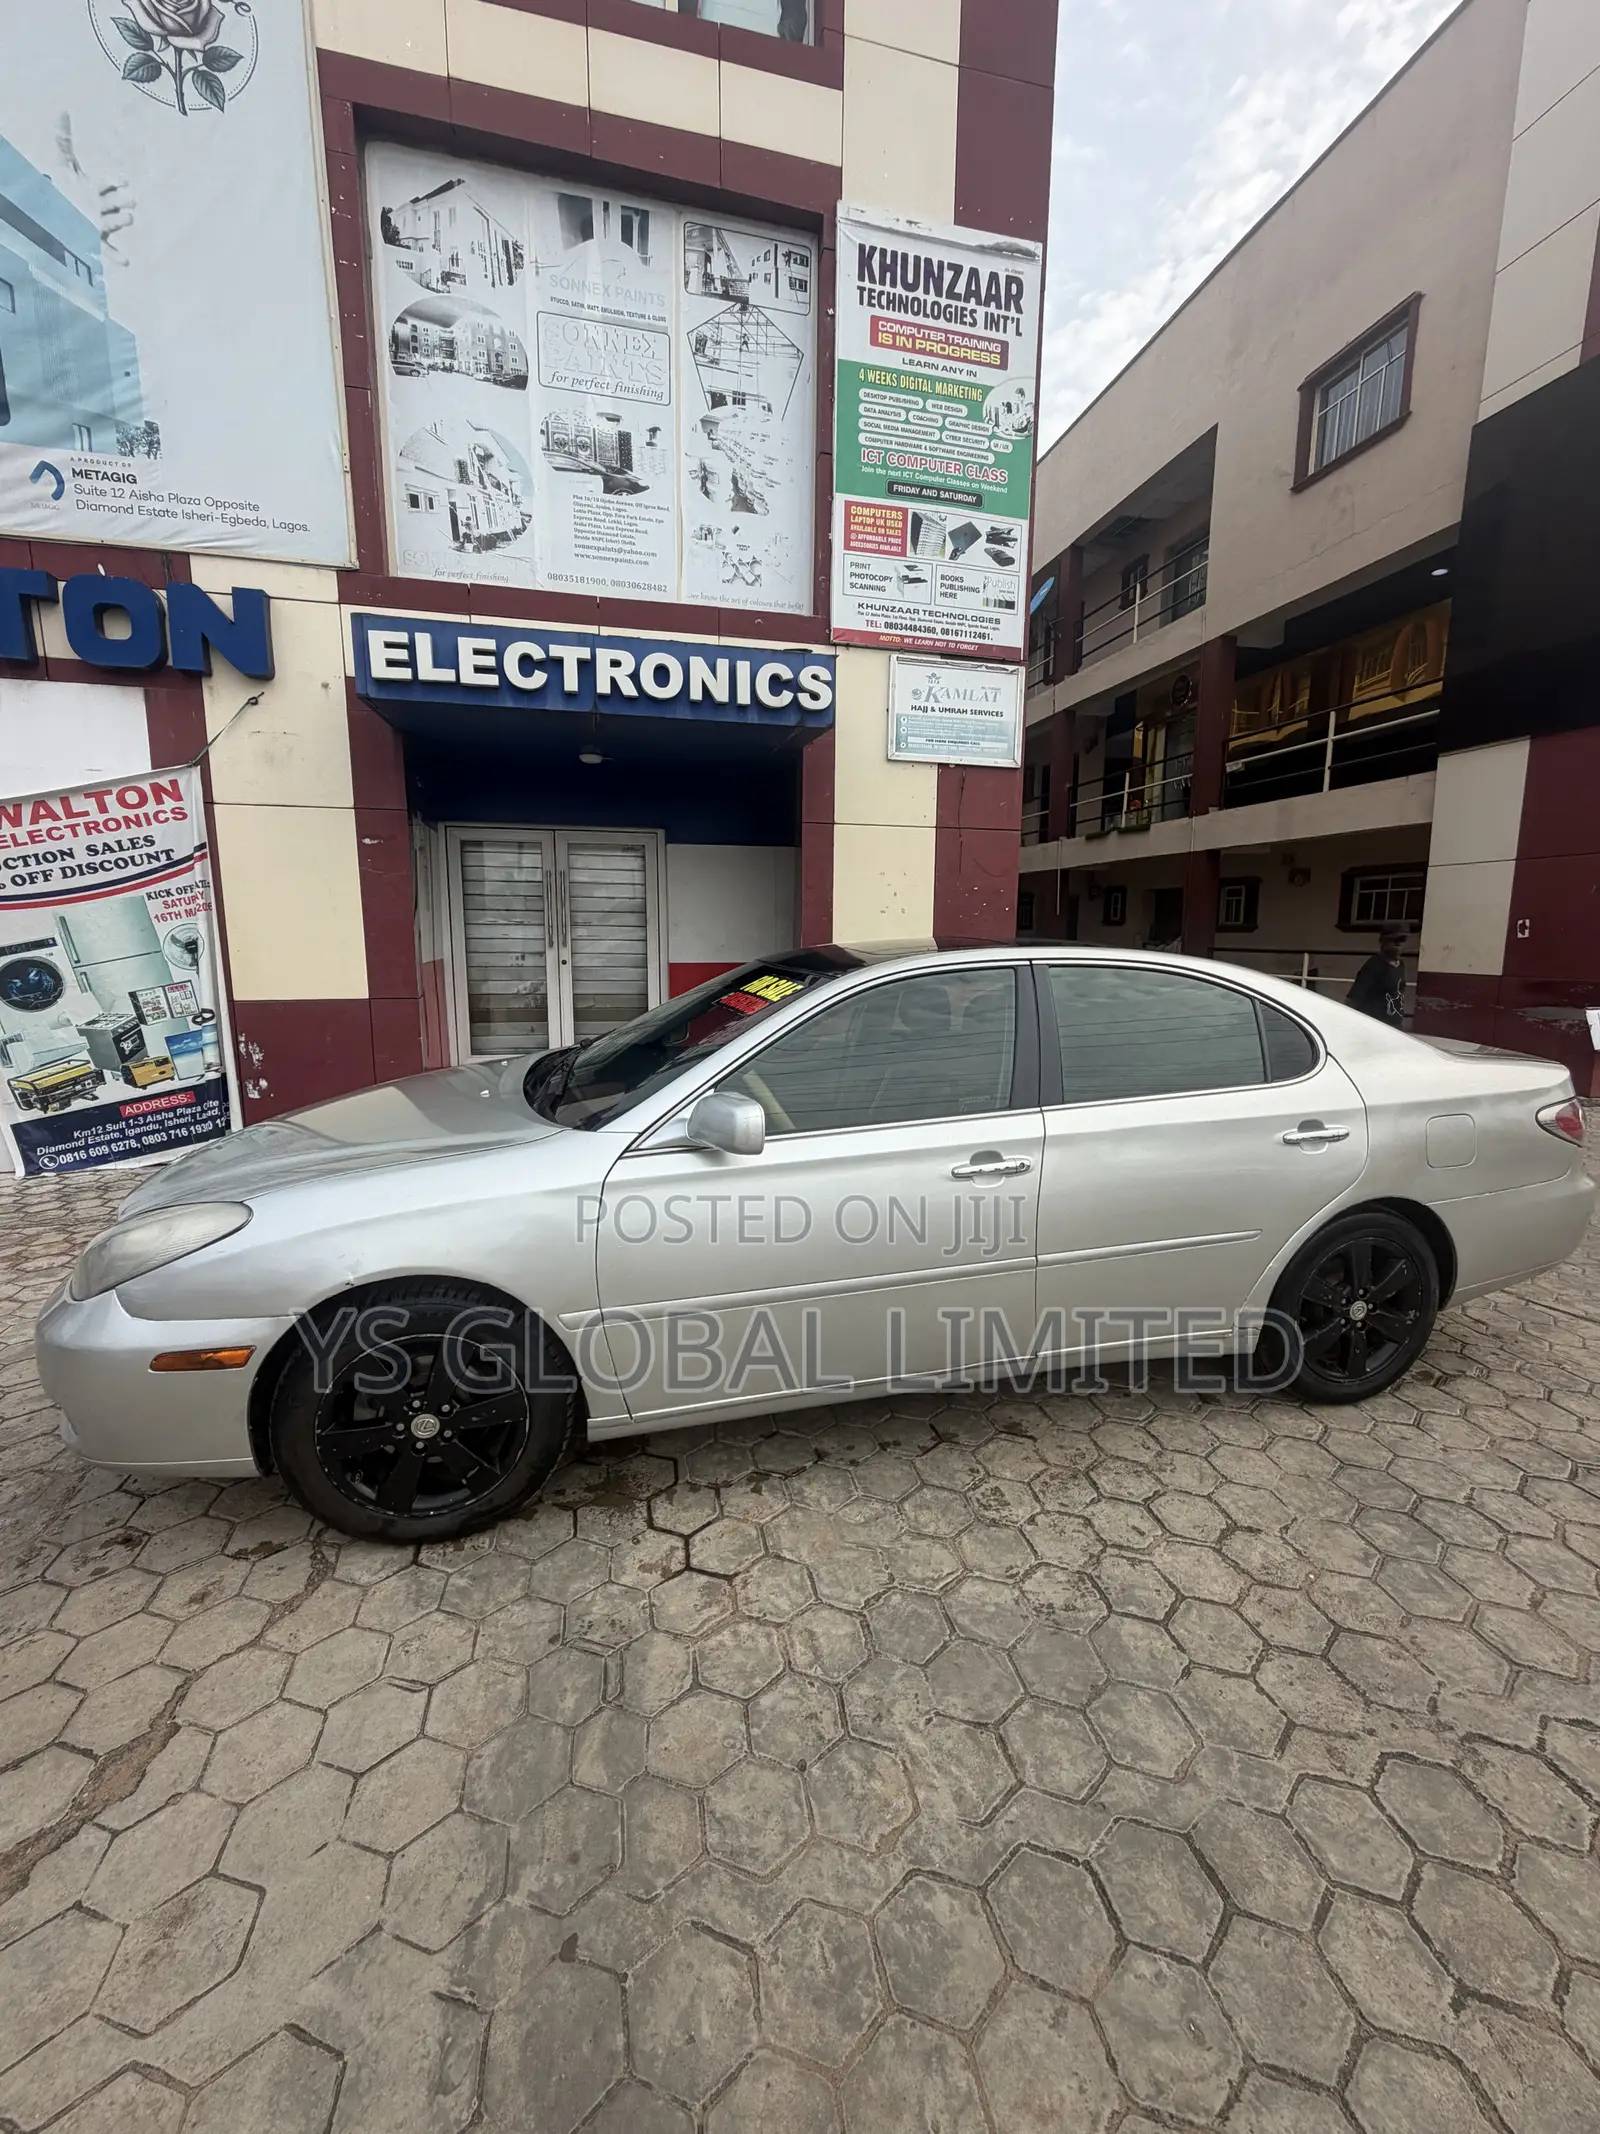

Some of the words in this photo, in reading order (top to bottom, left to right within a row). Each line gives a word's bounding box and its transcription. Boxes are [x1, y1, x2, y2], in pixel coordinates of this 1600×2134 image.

[857, 242, 1024, 314] KHUNZAAR
[549, 274, 611, 298] SONNEX
[615, 286, 665, 307] PAINTS
[626, 311, 646, 320] TEXTURE
[857, 285, 977, 328] TECHNOLOGIES
[983, 311, 1023, 337] INT'L
[878, 320, 946, 343] COMPUTER
[947, 333, 1001, 353] TRAINING
[877, 332, 893, 345] IS
[895, 335, 912, 349] IN
[915, 340, 1001, 366] PROGRESS
[902, 357, 939, 371] LEARN
[941, 365, 964, 376] ANY
[966, 369, 977, 378] IN
[548, 371, 569, 384] for
[571, 377, 610, 390] perfect
[612, 382, 664, 400] finishing
[858, 368, 865, 382] 4
[866, 369, 897, 388] WEEKS
[900, 374, 932, 393] DIGITAL
[935, 382, 983, 402] MARKETING
[863, 392, 887, 400] DESKTOP
[889, 396, 919, 406] PUBLISHING
[863, 406, 877, 414] DATA
[878, 409, 901, 418] ANALYSIS
[944, 405, 963, 414] DESIGN
[913, 415, 938, 424] COACHING
[948, 420, 970, 430] GRAPHIC
[971, 424, 989, 433] DESIGN
[863, 422, 882, 430] SOCIAL
[883, 424, 899, 432] MEDIA
[900, 426, 935, 437] MANAGEMENT
[864, 436, 893, 445] COMPUTER
[894, 440, 923, 450] HARDWARE
[929, 445, 956, 455] SOFTWARE
[956, 449, 989, 461] ENGINEERING
[945, 434, 961, 442] CYBER
[962, 436, 985, 446] SECURITY
[861, 448, 884, 464] ICT
[887, 452, 962, 475] COMPUTER
[965, 464, 1008, 483] CLASS
[71, 467, 138, 485] METAGIG
[861, 465, 875, 474] Join
[876, 467, 887, 476] the
[887, 470, 901, 478] next
[902, 471, 913, 480] ICT
[915, 473, 945, 485] Computer
[946, 476, 970, 487] Classes
[981, 482, 1008, 494] Weekend
[74, 483, 107, 497] Suite
[111, 488, 125, 499] 12
[128, 489, 164, 503] Aisha
[168, 492, 201, 506] Plaza
[204, 496, 260, 512] Opposite
[893, 484, 920, 496] FRIDAY
[921, 487, 938, 498] AND
[939, 489, 977, 504] SATURDAY
[76, 499, 134, 515] Diamond
[138, 505, 178, 519] Estate
[182, 509, 269, 529] Isheri-Egbeda,
[272, 518, 310, 533] Lagos.
[851, 506, 902, 520] COMPUTERS
[851, 515, 875, 525] LAPTOP
[876, 518, 885, 527] UK
[886, 520, 902, 528] USED
[574, 543, 657, 557] sonnexpaints@yahoo.com
[574, 552, 649, 566] www.sonnexpaints.com
[850, 561, 871, 571] PRINT
[433, 568, 445, 577] for
[475, 571, 509, 583] finishing
[547, 572, 609, 587] 08035181900,
[610, 579, 668, 592] 08030628482
[850, 572, 893, 583] PHOTOCOPY
[940, 574, 964, 583] BOOKS
[849, 582, 887, 593] SCANNING
[939, 591, 958, 600] HERE
[940, 582, 980, 594] PUBLISHING
[858, 602, 920, 616] KHUNZAAR
[922, 609, 1001, 625] TECHNOLOGIES
[865, 619, 882, 629] TEL:
[884, 621, 939, 636] 08034484360,
[914, 638, 934, 646] LEARN
[367, 629, 833, 711] ELECTRONICS
[924, 685, 1001, 703] KAMLAT
[910, 705, 928, 713] HAJJ
[938, 707, 968, 715] UMRAH
[970, 709, 1004, 717] SERVICES
[0, 847, 75, 872] CTION
[85, 835, 156, 857] SALES
[10, 868, 54, 887] OFF
[59, 848, 175, 880] DISCOUNT
[146, 888, 174, 901] KICK
[176, 884, 195, 895] OFF
[154, 910, 182, 923] 16TH
[756, 979, 806, 1002] SALE
[125, 1093, 192, 1115] ADDRESS:
[73, 1125, 103, 1139] Km12
[105, 1121, 126, 1131] Suit
[128, 1116, 144, 1126] 1-3
[146, 1111, 174, 1123] Aisha
[176, 1105, 202, 1116] Plaza
[37, 1139, 85, 1155] Diamond
[87, 1132, 123, 1145] Estate,
[164, 1114, 194, 1128] Isheri,
[60, 1150, 87, 1164] 0816
[88, 1145, 109, 1158] 609
[110, 1138, 140, 1153] 6278,
[142, 1132, 168, 1146] 0803
[168, 1127, 188, 1139] 716
